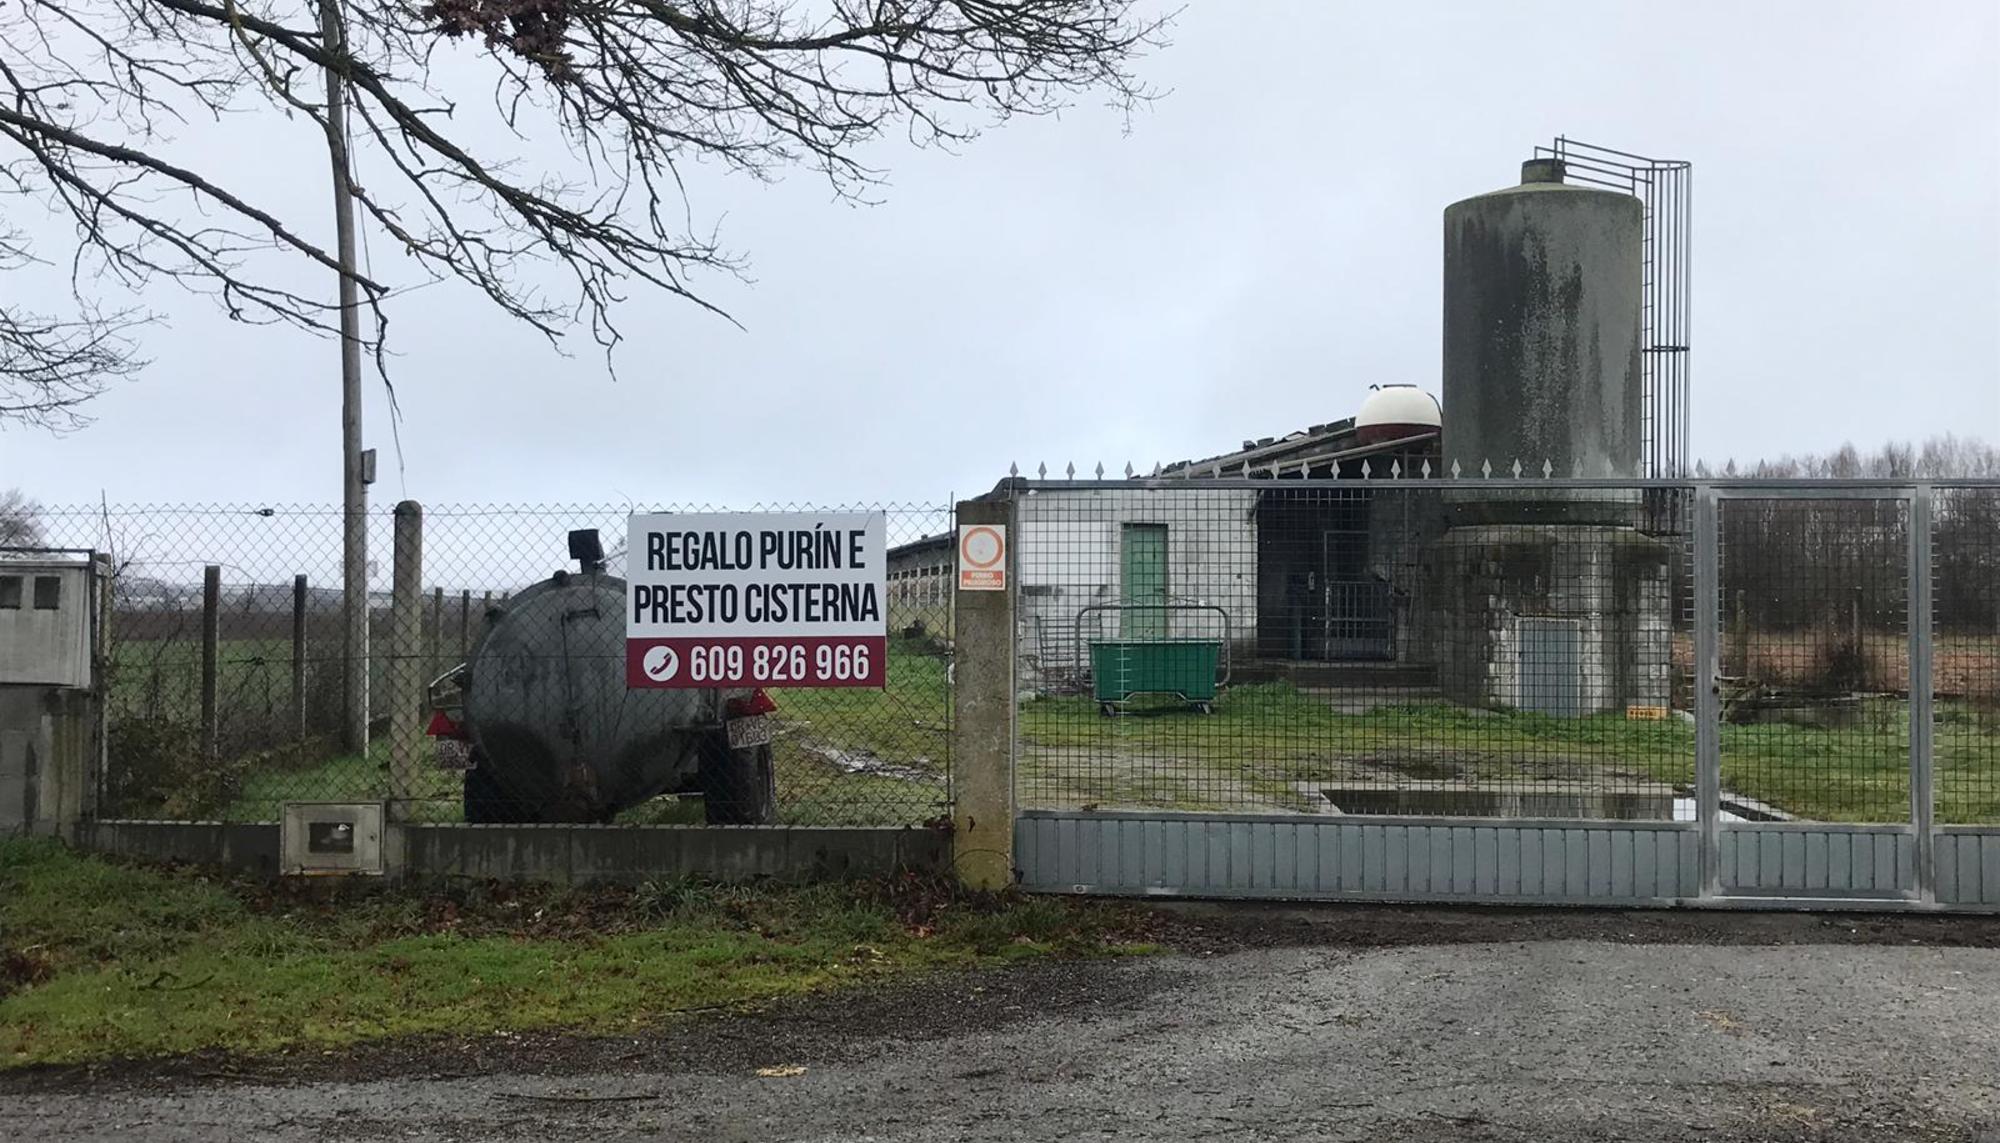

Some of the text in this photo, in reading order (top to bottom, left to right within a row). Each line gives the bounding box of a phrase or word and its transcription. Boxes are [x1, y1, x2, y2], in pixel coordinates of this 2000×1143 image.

[647, 522, 866, 571] REGALO PURÍN E
[634, 582, 880, 625] PRESTO CISTERNA
[690, 644, 869, 681] 609 826 966
